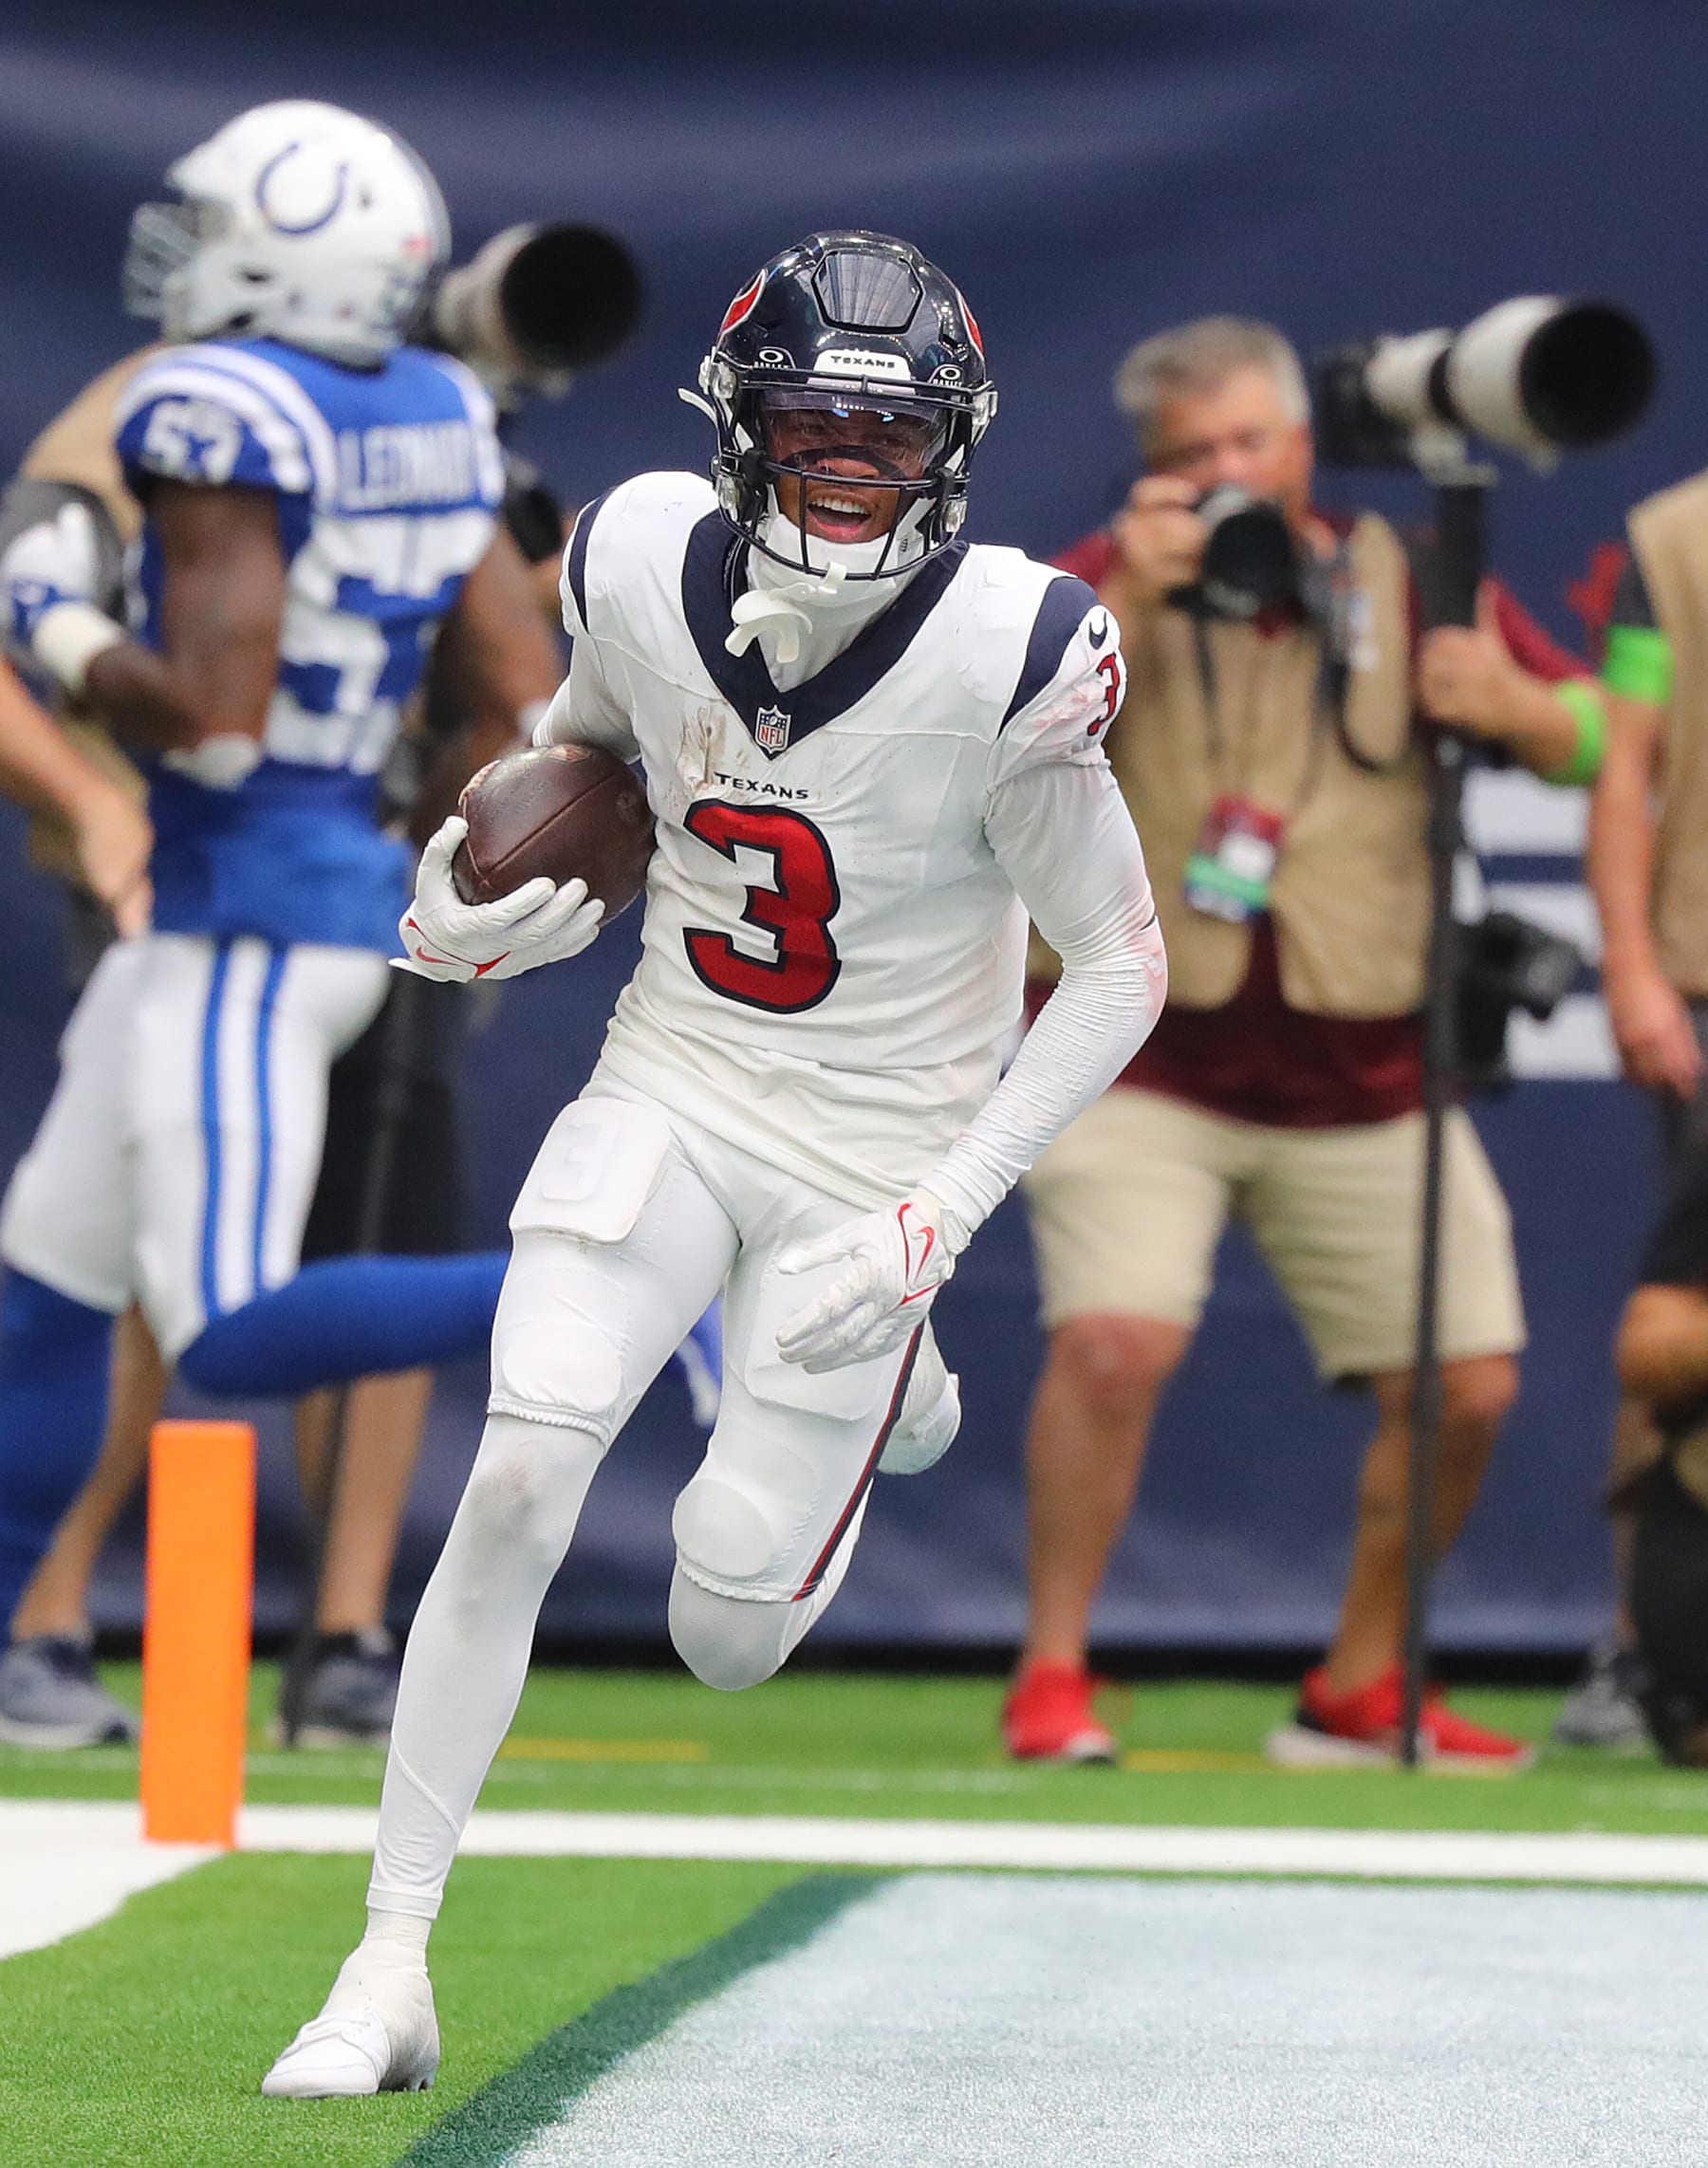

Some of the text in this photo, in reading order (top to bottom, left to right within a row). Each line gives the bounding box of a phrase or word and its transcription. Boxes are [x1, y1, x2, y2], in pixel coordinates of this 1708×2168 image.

[830, 355, 895, 369] TEXANS
[1086, 651, 1121, 737] 3
[760, 725, 783, 745] NFL
[714, 770, 809, 800] TEXANS
[682, 798, 842, 1015] 3
